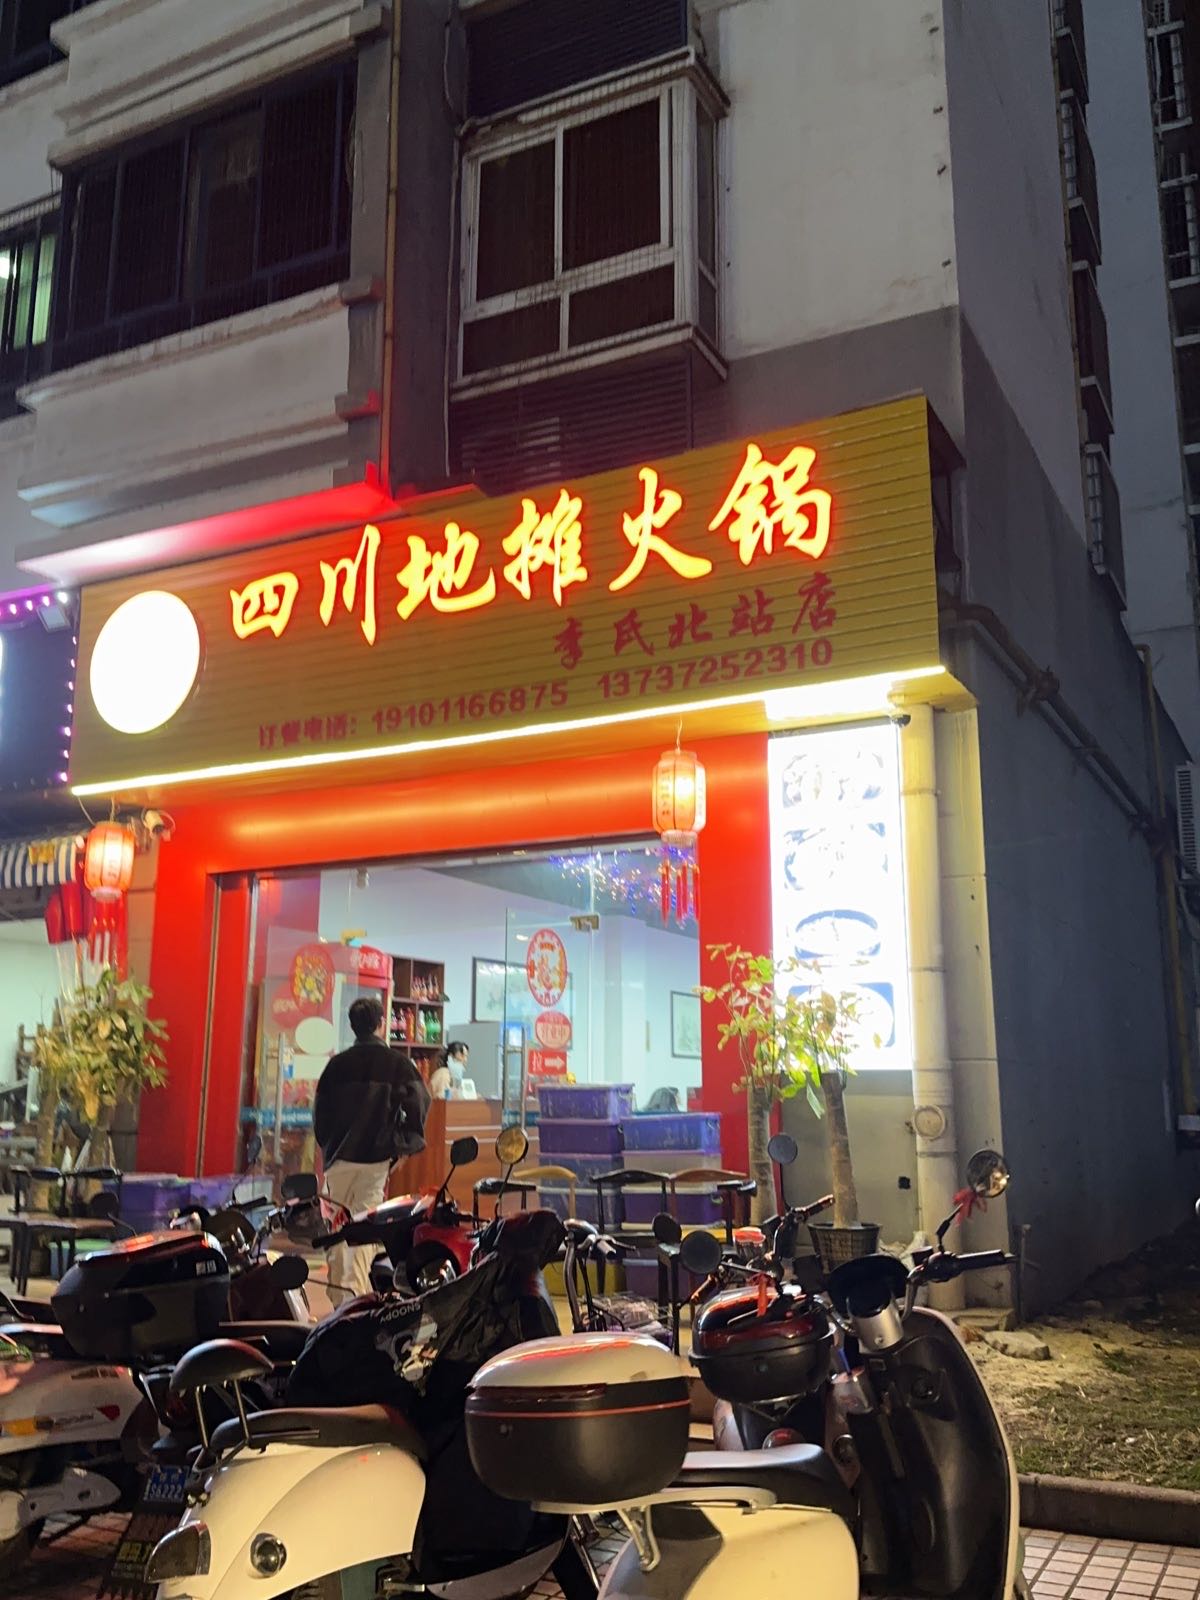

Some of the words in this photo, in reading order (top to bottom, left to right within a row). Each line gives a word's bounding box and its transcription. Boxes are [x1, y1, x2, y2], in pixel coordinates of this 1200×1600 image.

[229, 443, 832, 645] 四川地摊火锅
[553, 571, 838, 670] 李氏北站店
[371, 681, 568, 733] 19101166875
[597, 639, 833, 700] 13737252310
[380, 1303, 421, 1324] SNOOPY
